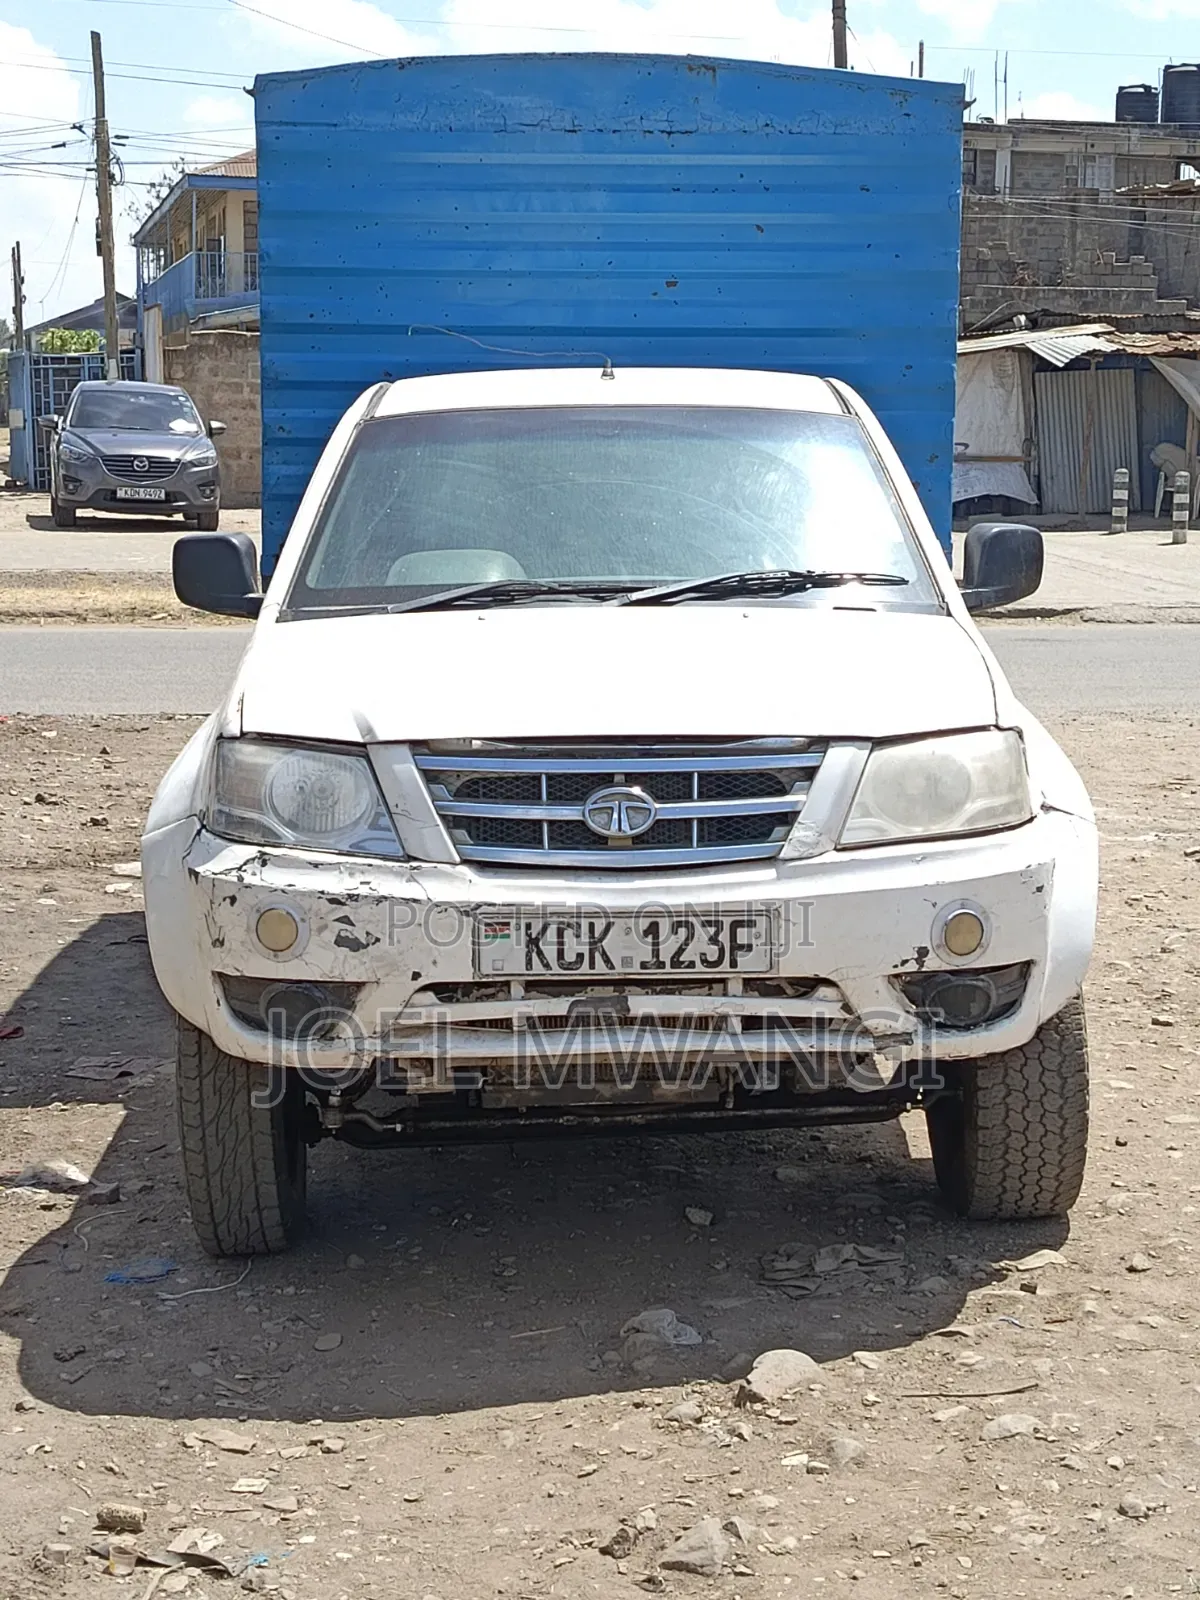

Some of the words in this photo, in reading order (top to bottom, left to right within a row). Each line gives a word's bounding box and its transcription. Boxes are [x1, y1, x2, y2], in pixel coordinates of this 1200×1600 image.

[124, 489, 140, 497] KDN
[525, 920, 616, 971] KCK
[639, 919, 757, 970] 123F
